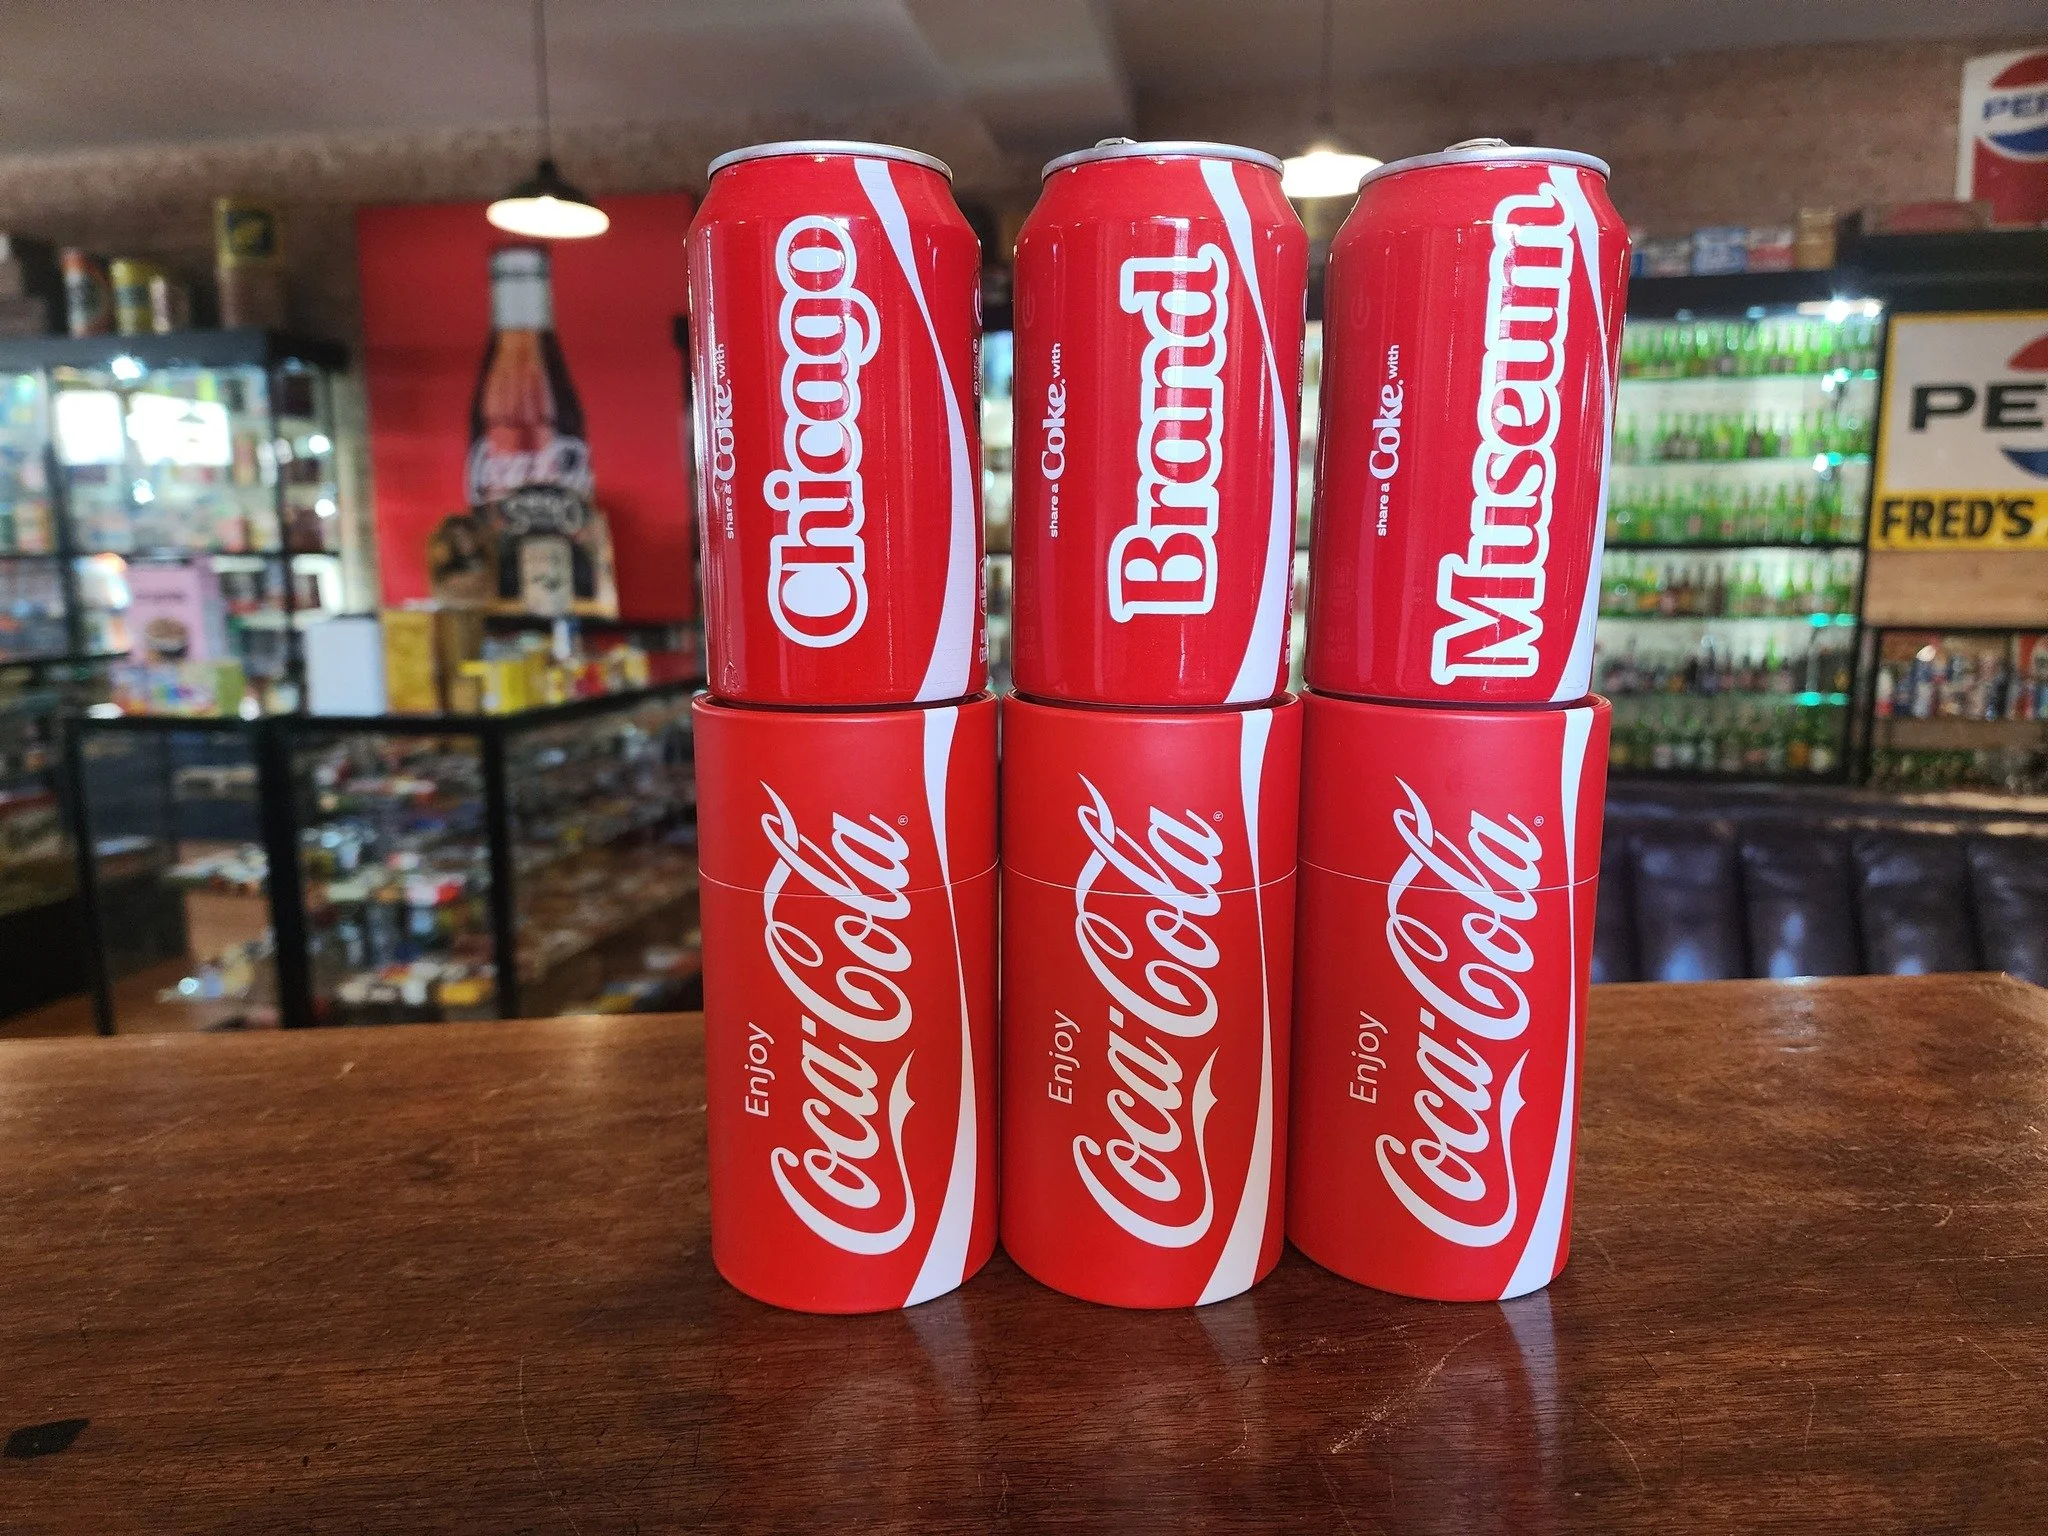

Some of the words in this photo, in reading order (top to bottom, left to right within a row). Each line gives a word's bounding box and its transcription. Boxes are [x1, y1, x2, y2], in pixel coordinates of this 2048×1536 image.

[716, 343, 726, 379] with
[1051, 342, 1061, 379] with
[1388, 344, 1400, 380] with
[714, 379, 736, 481] Coke
[763, 215, 881, 648] Chicago
[1041, 378, 1067, 481] Coke
[1108, 242, 1230, 624] Brand
[1369, 379, 1404, 480] Coke
[1431, 181, 1575, 686] Museum
[725, 498, 735, 540] share
[1049, 495, 1059, 538] share
[1051, 483, 1059, 494] a
[1376, 494, 1390, 537] share
[1380, 482, 1390, 493] a
[1878, 497, 2036, 540] FRED'S
[759, 780, 916, 1256] Coca-Cola
[1048, 1009, 1081, 1106] Enjoy
[1072, 772, 1225, 1249] Coca-Cola
[1349, 1010, 1390, 1105] Enjoy
[1375, 775, 1545, 1248] Coca-Cola
[745, 1021, 776, 1118] Enjoy
